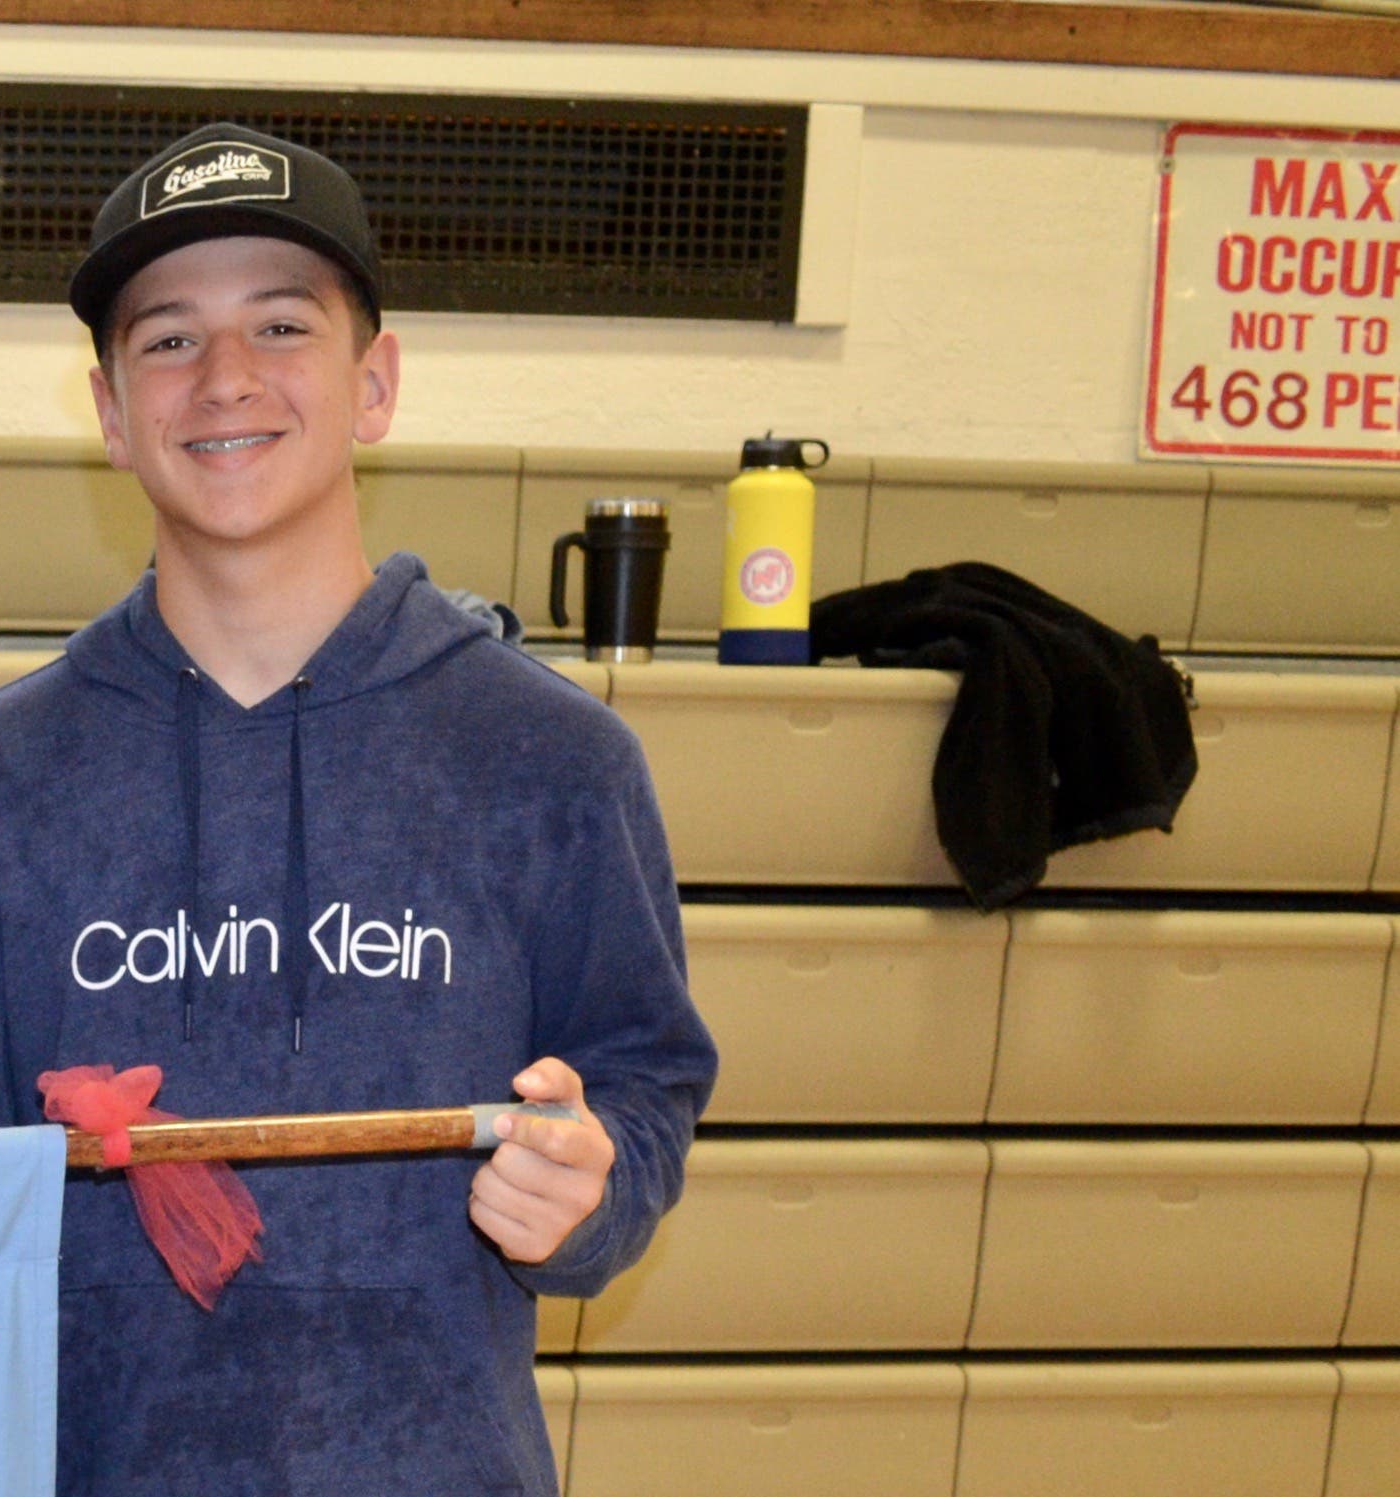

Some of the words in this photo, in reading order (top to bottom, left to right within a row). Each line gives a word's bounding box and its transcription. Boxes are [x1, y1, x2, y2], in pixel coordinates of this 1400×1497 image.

[163, 151, 263, 193] Gasoline
[1249, 157, 1400, 222] MAX
[1230, 311, 1313, 352] NOT
[1336, 314, 1389, 355] TO
[1171, 365, 1309, 430] 468
[1323, 372, 1400, 431] PE
[72, 904, 279, 990] Calvin
[308, 902, 453, 984] Klein
